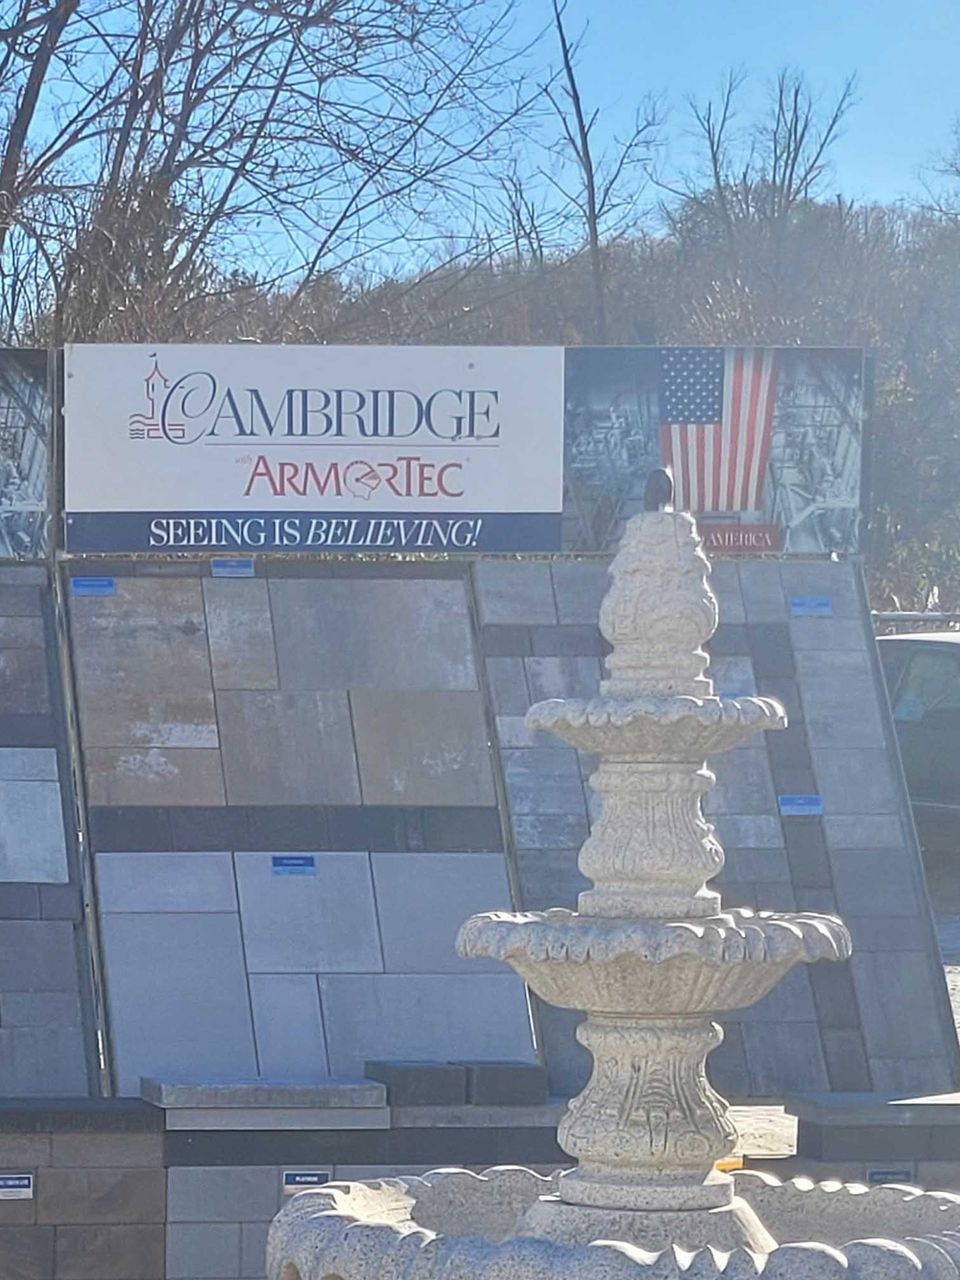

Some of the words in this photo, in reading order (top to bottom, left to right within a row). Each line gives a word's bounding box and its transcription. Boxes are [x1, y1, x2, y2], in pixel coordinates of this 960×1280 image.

[161, 371, 500, 445] CAMBRIDGE
[149, 519, 266, 546] SEEING
[272, 520, 300, 545] IS
[305, 518, 482, 547] BELIEVING!
[707, 533, 772, 546] AMERICA
